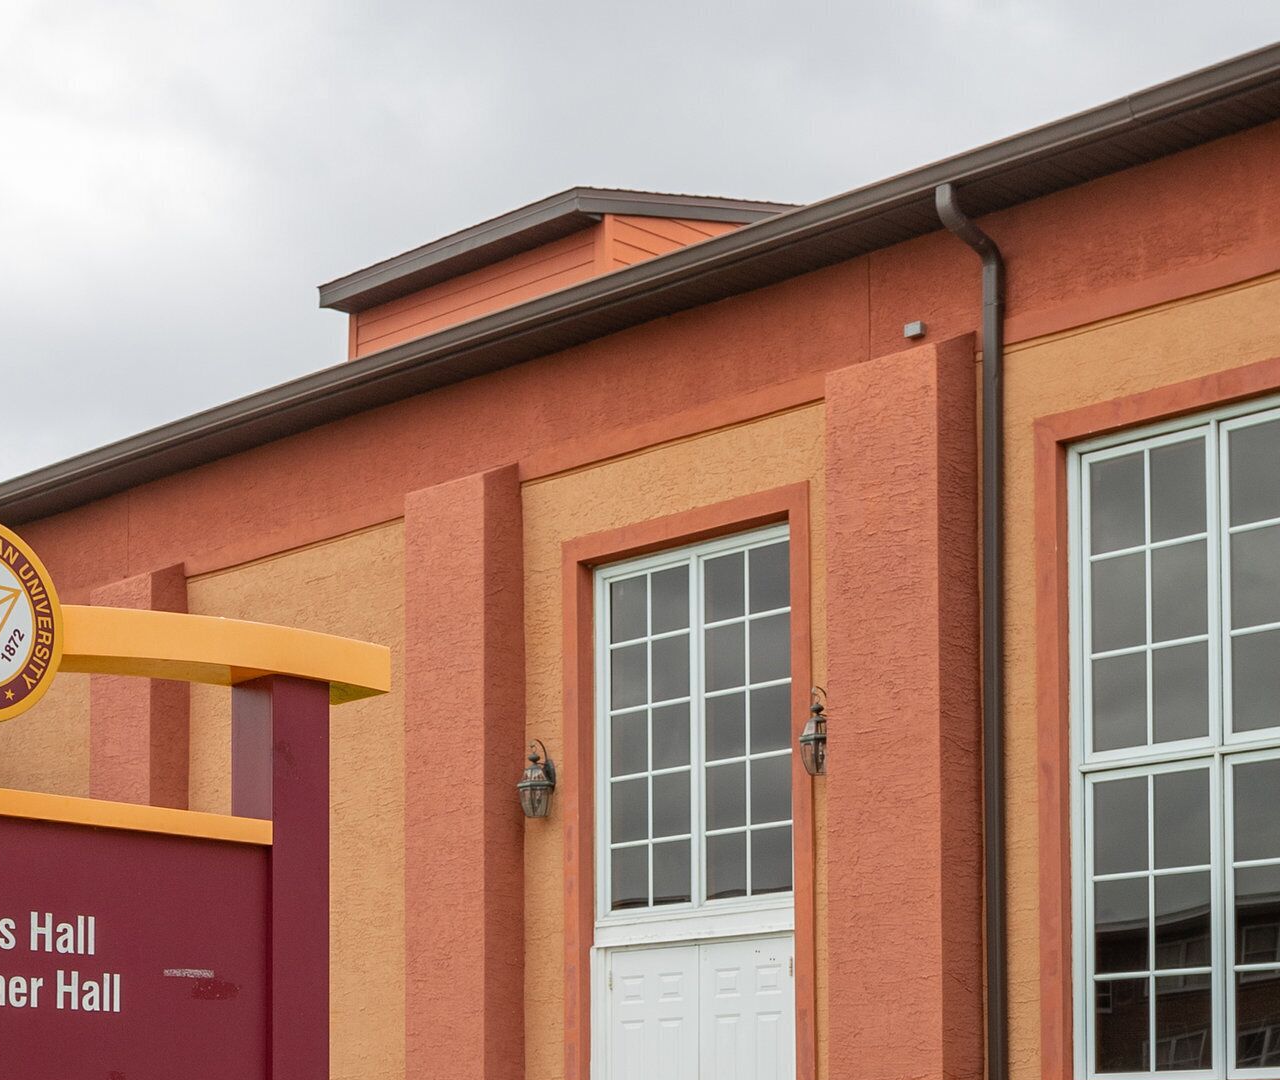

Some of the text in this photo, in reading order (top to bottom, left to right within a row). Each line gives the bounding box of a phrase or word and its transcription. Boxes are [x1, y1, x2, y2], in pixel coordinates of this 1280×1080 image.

[0, 627, 25, 664] 1872
[18, 562, 55, 690] UNIVERSITY
[30, 911, 96, 956] Hall
[56, 969, 121, 1013] Hall
